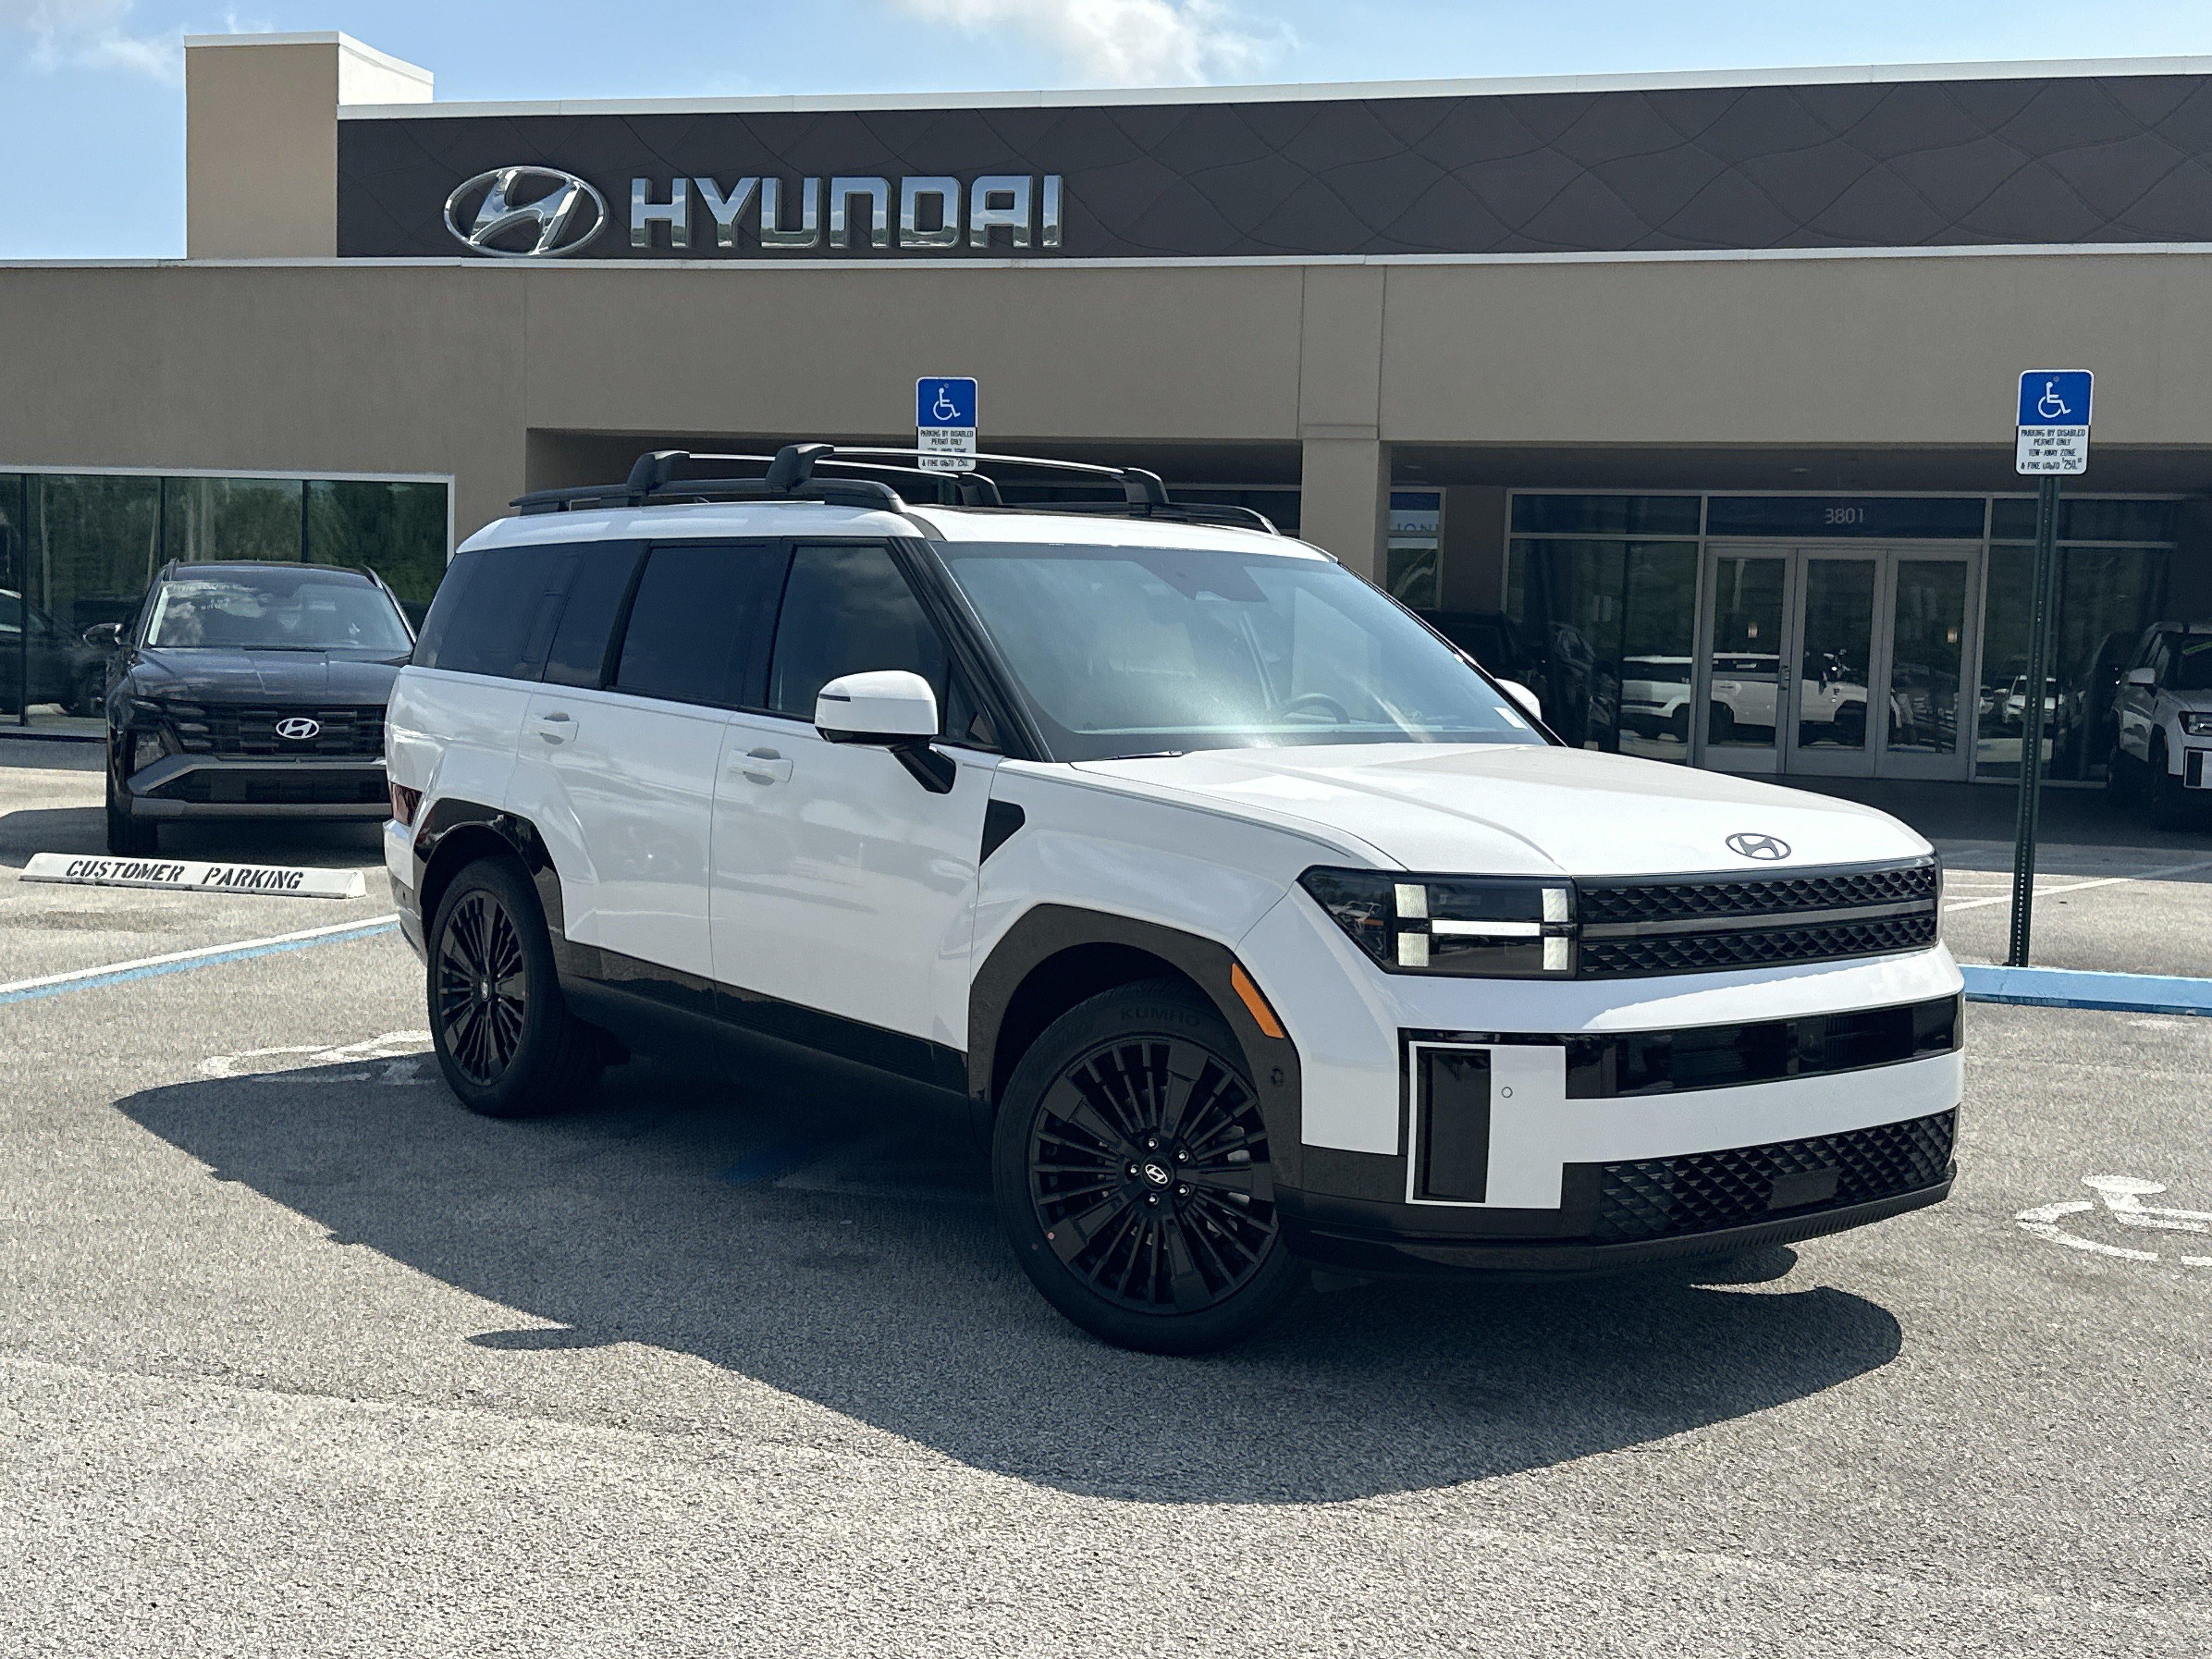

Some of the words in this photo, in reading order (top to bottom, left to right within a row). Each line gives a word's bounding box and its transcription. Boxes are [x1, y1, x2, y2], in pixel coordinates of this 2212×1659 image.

[629, 173, 1064, 250] HYUNDAI
[1825, 507, 1864, 524] 3801
[65, 859, 185, 882] CUSTOMER
[201, 867, 304, 890] PARKING
[1120, 1006, 1201, 1028] KUMHO
